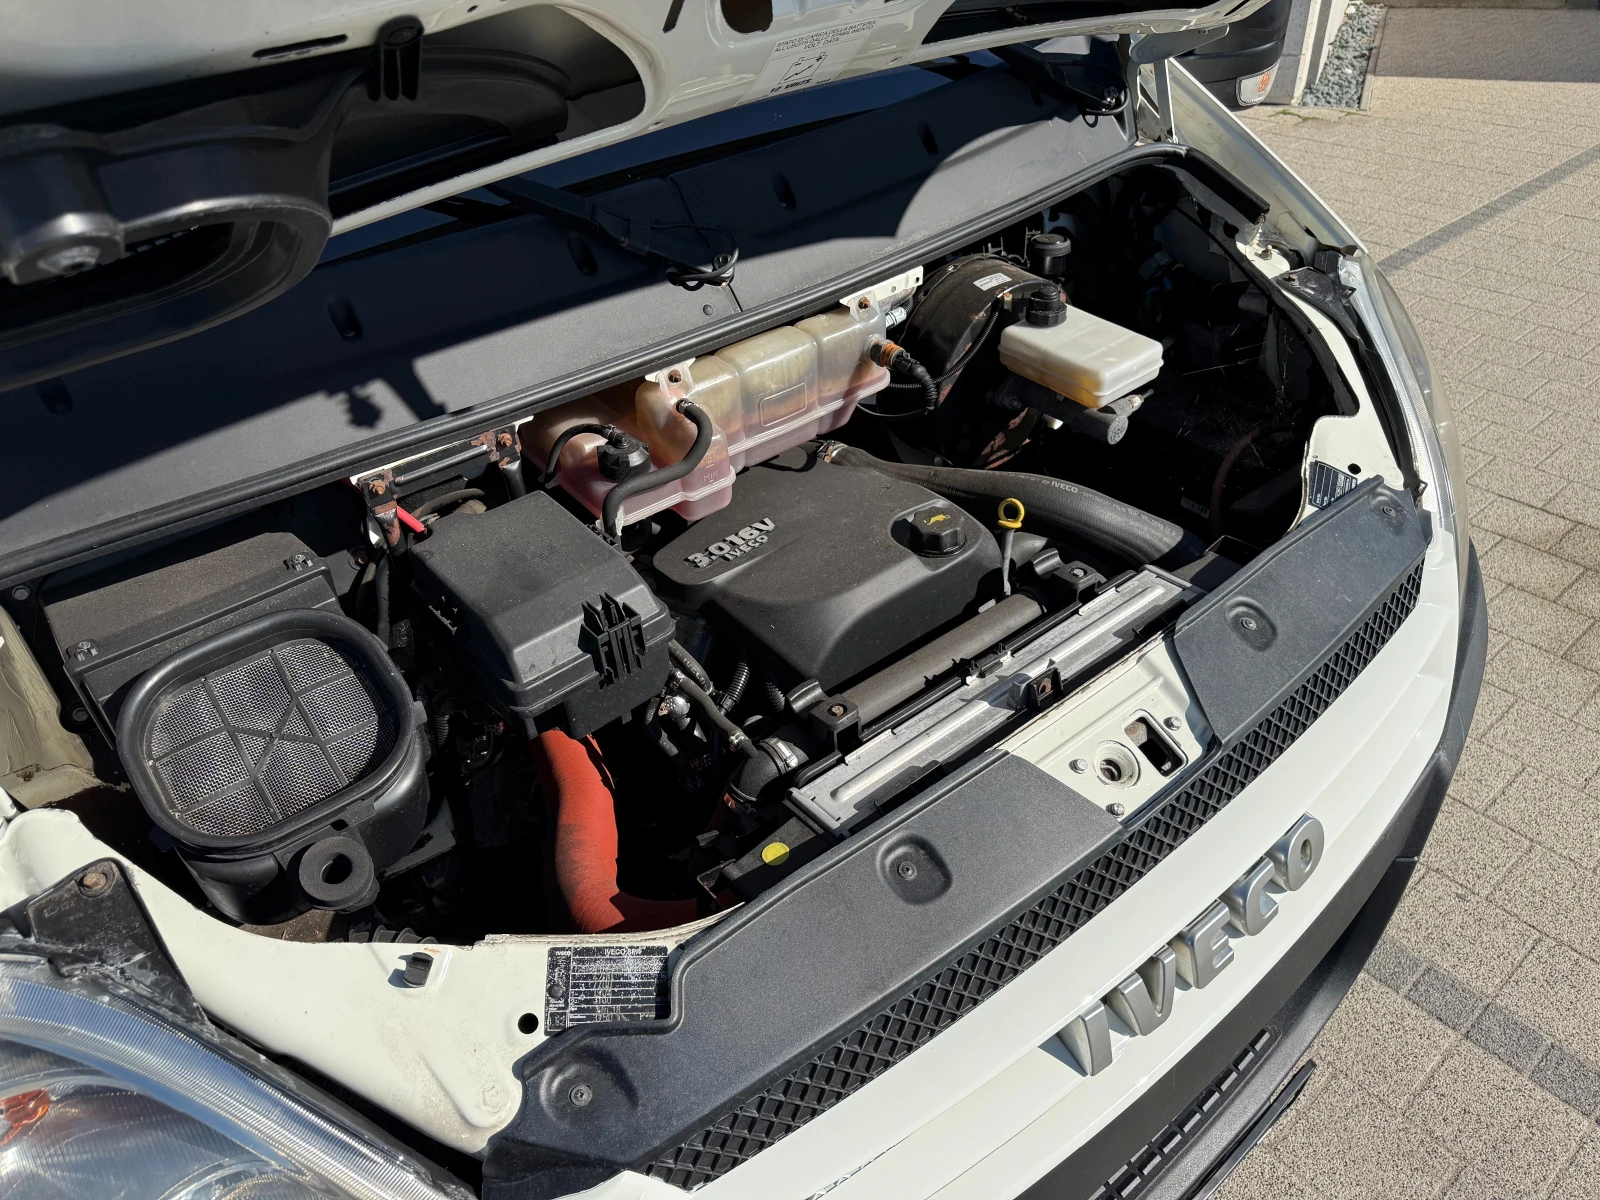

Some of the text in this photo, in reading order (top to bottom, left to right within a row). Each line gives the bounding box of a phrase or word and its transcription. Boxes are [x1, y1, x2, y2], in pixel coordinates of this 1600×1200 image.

[776, 38, 798, 48] STATO
[805, 31, 828, 41] CARICA
[828, 26, 848, 35] DELLA
[803, 37, 840, 50] VOLT DATA
[809, 35, 830, 44] DALLO
[830, 25, 874, 39] STABILIMENTO
[1051, 480, 1079, 494] IVECO
[723, 534, 769, 561] IVECO
[604, 948, 626, 956] IVECO
[1056, 811, 1325, 1077] IVECO
